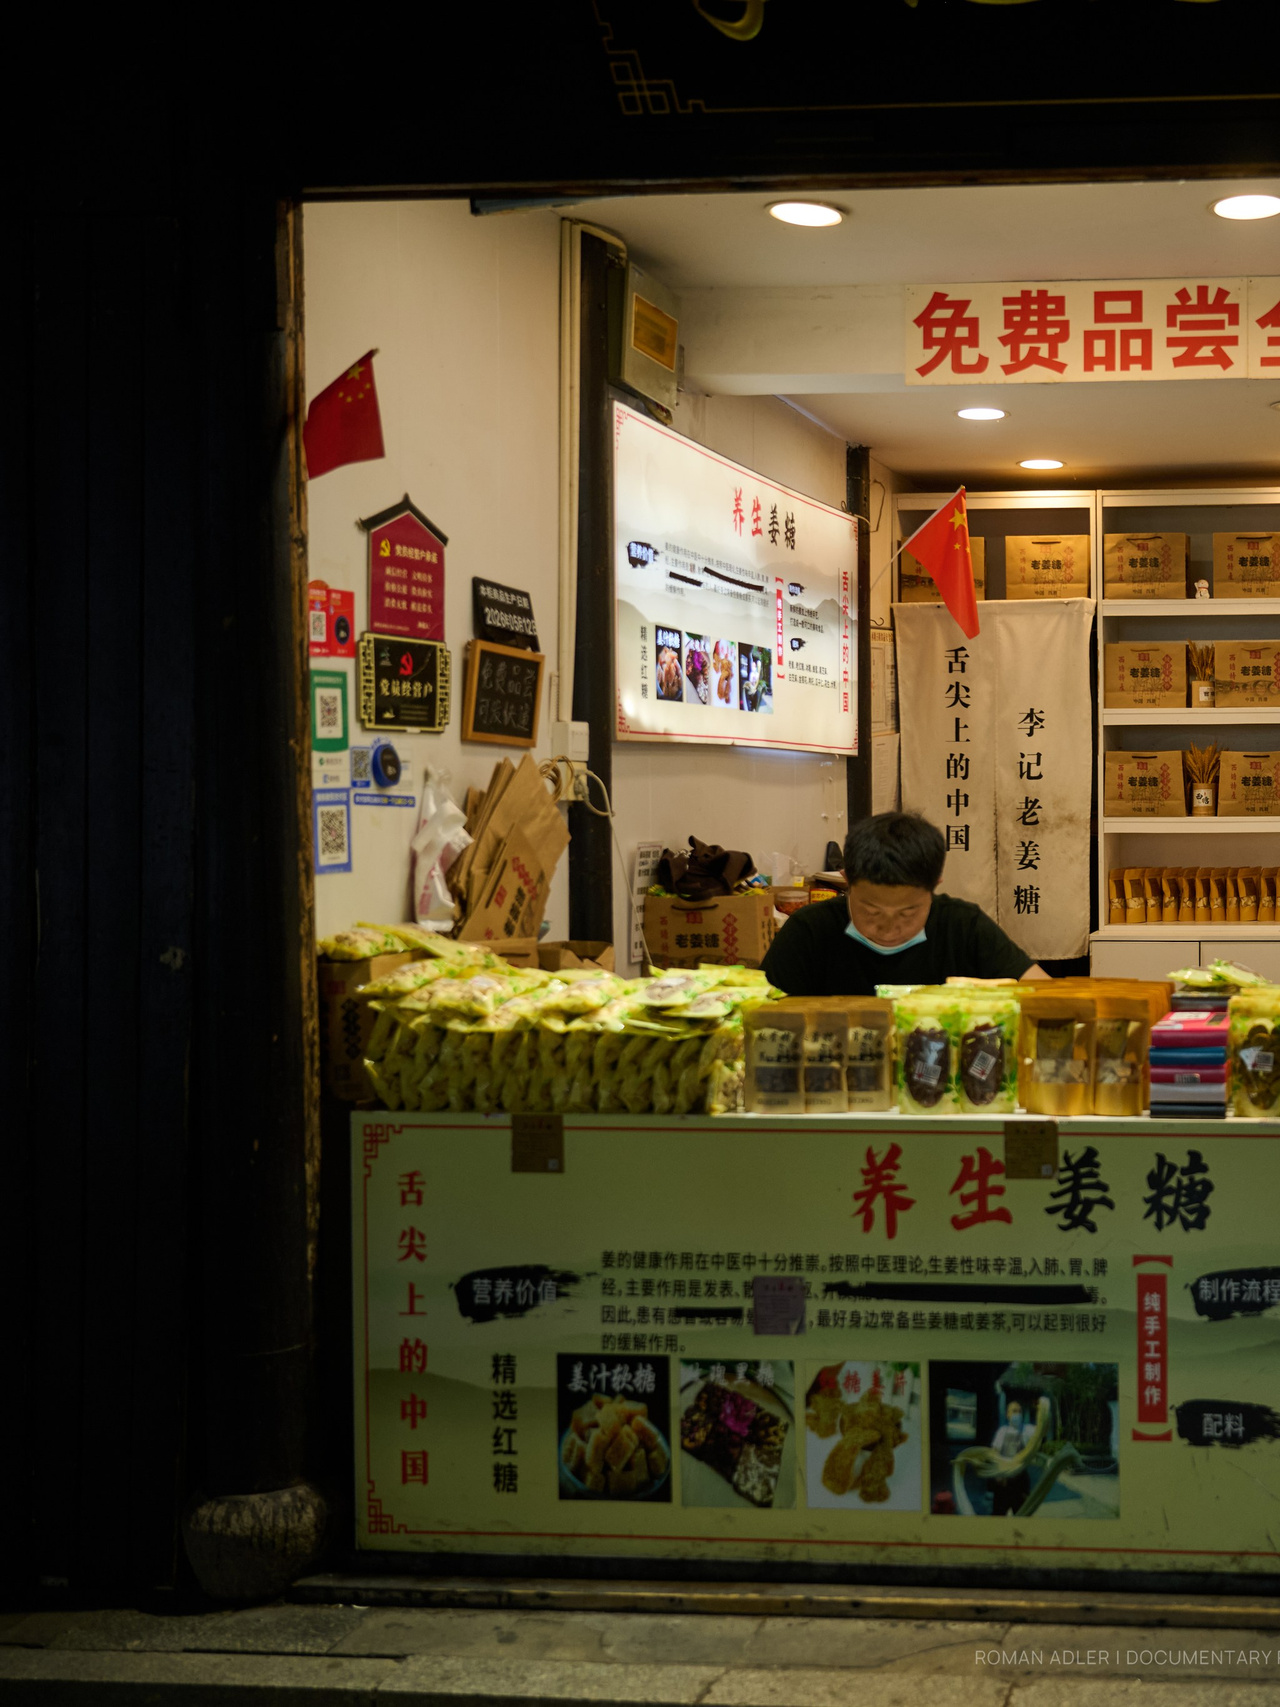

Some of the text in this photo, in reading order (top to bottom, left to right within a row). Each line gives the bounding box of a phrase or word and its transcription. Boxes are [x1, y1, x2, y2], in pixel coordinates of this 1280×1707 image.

[732, 487, 797, 551] 养生姜糖
[1031, 560, 1062, 570] 老姜糖
[1129, 558, 1159, 568] 老姜糖
[1238, 556, 1270, 567] 老姜糖
[841, 571, 850, 713] 舌尖上的中国
[1130, 668, 1160, 678] 老姜糖
[1241, 666, 1272, 676] 老姜糖
[380, 678, 433, 698] 党员经营户
[944, 646, 971, 852] 舌尖上的中国
[1128, 776, 1158, 787] 老姜糖
[1241, 776, 1272, 787] 老姜糖
[1013, 707, 1046, 915] 李记老姜糖
[675, 933, 719, 949] 老姜糖
[851, 1142, 1215, 1240] 养生姜糖
[471, 1277, 558, 1305] 营养价值
[396, 1170, 429, 1487] 舌尖上的中国
[602, 1333, 689, 1354] 的缓解作用。
[1143, 1292, 1162, 1406] 纯手工制作
[567, 1363, 657, 1394] 姜汁软糖
[491, 1353, 519, 1493] 精选红糖
[1202, 1413, 1244, 1438] 配料
